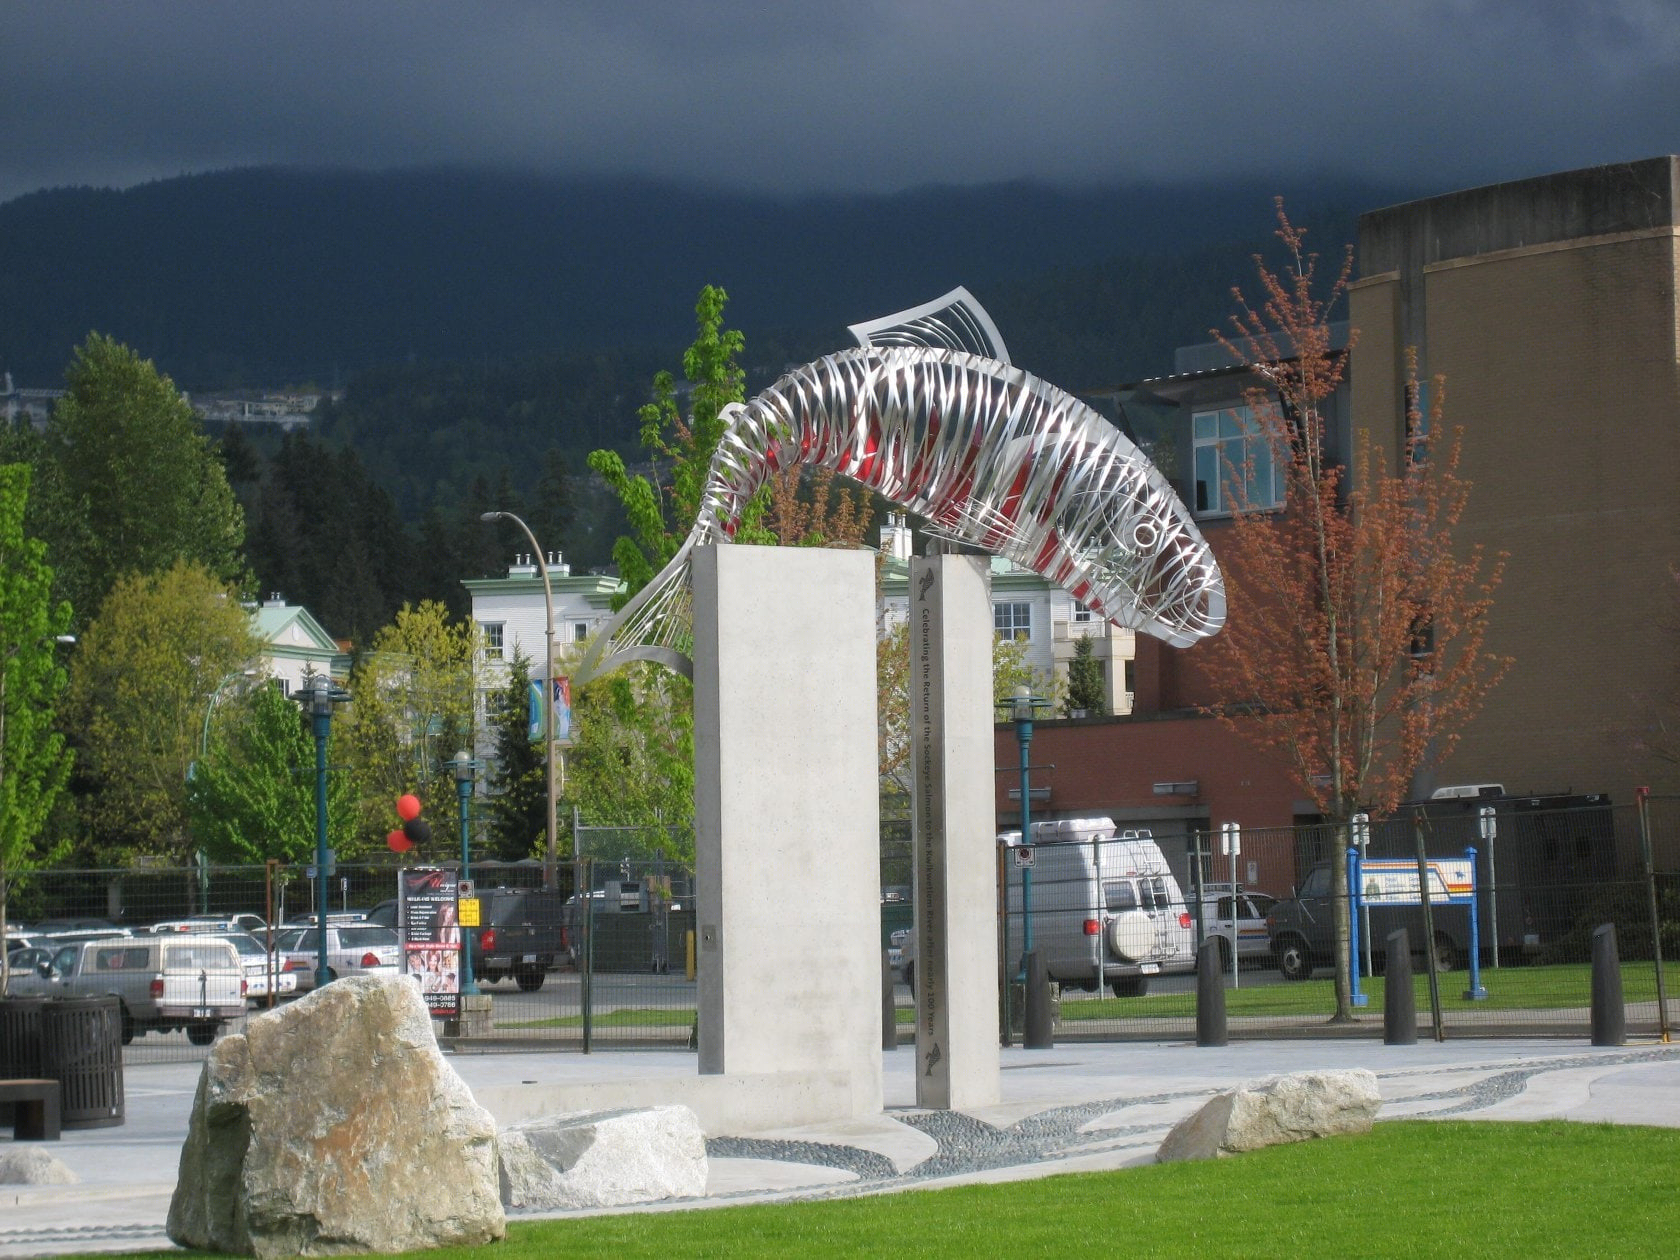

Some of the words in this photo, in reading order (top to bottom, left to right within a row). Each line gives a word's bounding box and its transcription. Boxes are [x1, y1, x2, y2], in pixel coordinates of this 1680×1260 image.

[921, 608, 931, 662] Celebrating
[922, 663, 931, 679] the
[923, 681, 931, 712] Return
[923, 714, 932, 724] of
[923, 726, 932, 742] the
[922, 744, 932, 780] Sockeye
[924, 783, 933, 818] Salmon
[924, 820, 933, 830] to
[925, 831, 934, 848] the
[926, 910, 935, 932] River
[927, 935, 935, 958] after
[924, 960, 935, 990] nearly
[927, 992, 935, 1010] 100
[927, 1011, 936, 1036] Years
